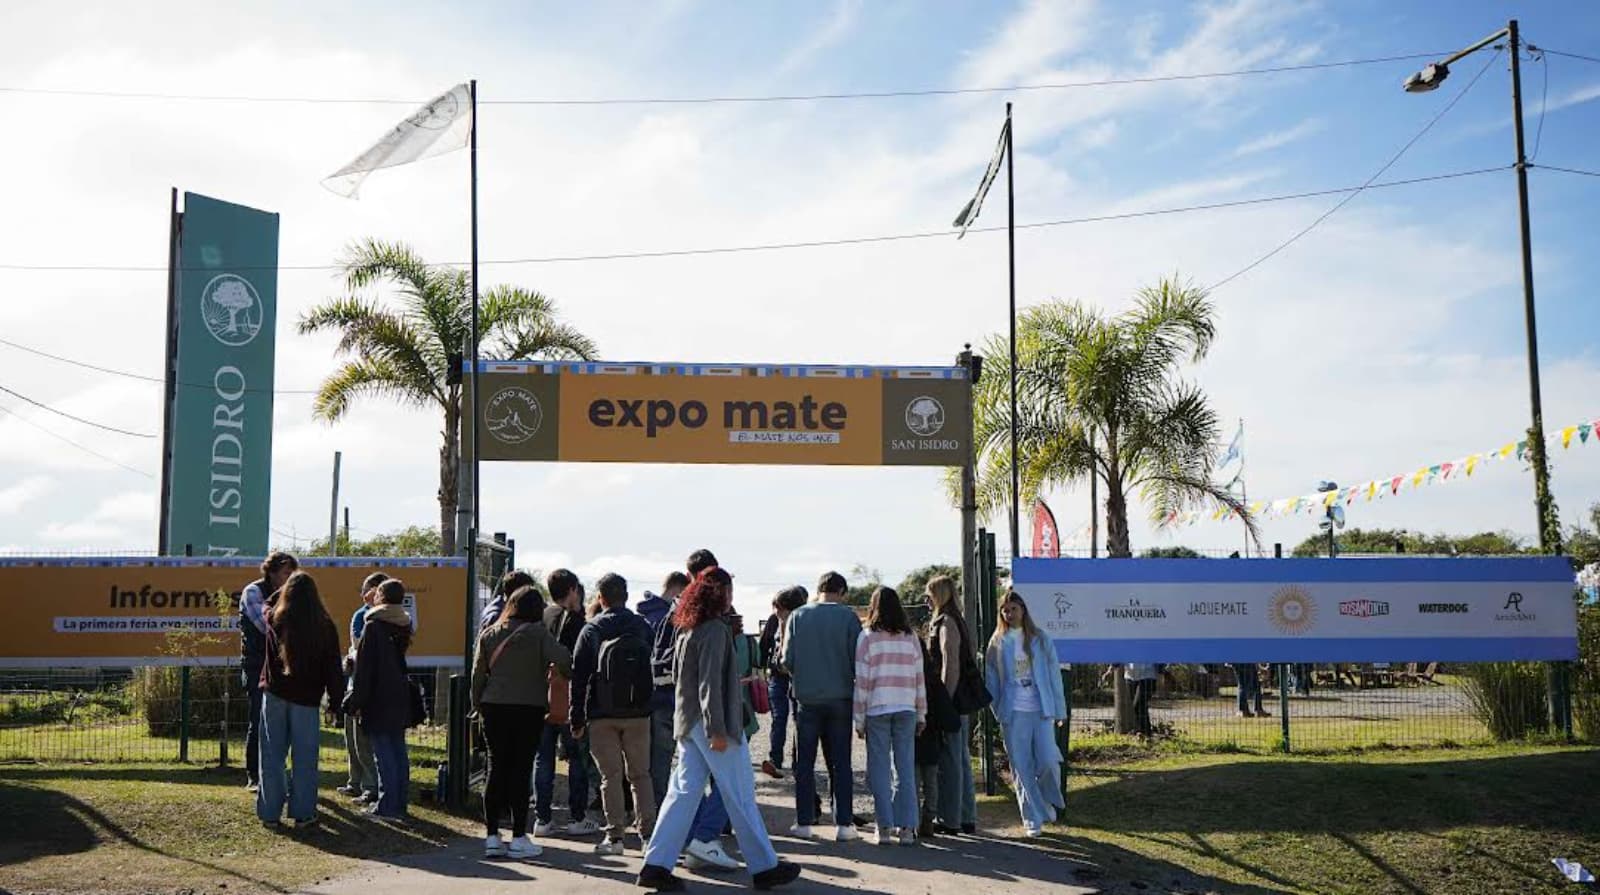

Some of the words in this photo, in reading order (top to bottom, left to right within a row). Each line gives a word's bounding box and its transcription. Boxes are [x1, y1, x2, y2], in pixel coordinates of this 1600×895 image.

[493, 390, 515, 406] EXPO
[518, 391, 537, 410] MATE
[588, 397, 708, 438] expo
[723, 394, 848, 429] mate
[208, 365, 247, 529] ISIDRO
[891, 439, 915, 450] SAN
[919, 439, 959, 450] ISIDRO
[1129, 598, 1141, 607] LA
[1186, 601, 1248, 616] JAQUEMATE
[1339, 600, 1390, 618] ROSAMONTE
[1418, 602, 1469, 614] WATERDOG
[1104, 607, 1167, 622] TRANQUERA
[63, 618, 77, 629] La
[79, 618, 127, 632] primera
[130, 618, 158, 629] feria
